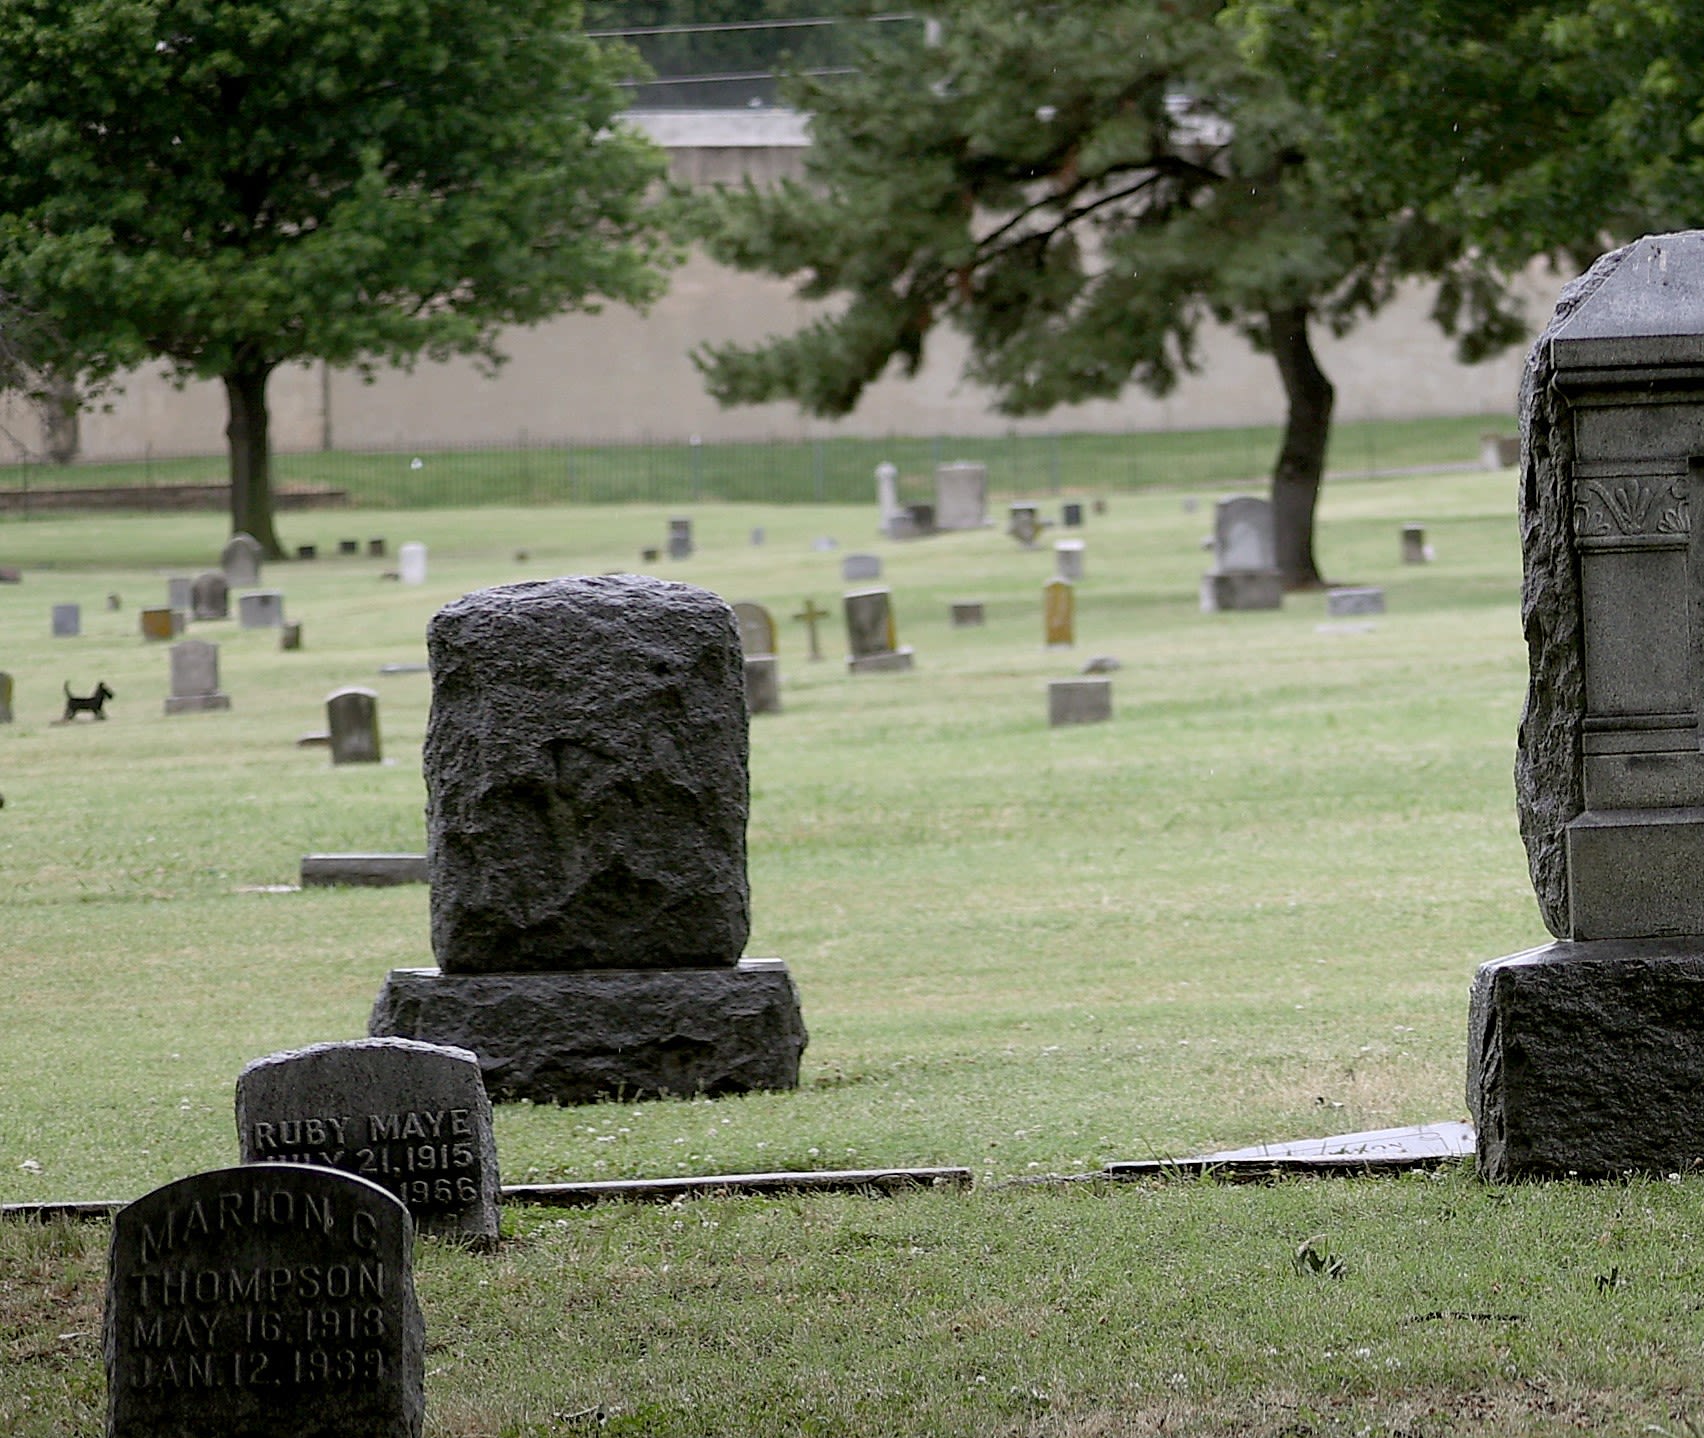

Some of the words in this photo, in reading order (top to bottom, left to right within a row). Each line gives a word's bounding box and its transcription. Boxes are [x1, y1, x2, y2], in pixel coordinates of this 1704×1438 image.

[256, 1116, 352, 1150] RUBY
[368, 1108, 470, 1141] MAYE
[402, 1177, 478, 1203] 1966
[142, 1187, 335, 1264] MARION
[132, 1262, 385, 1306] THOMPSON
[134, 1314, 221, 1348] MAY
